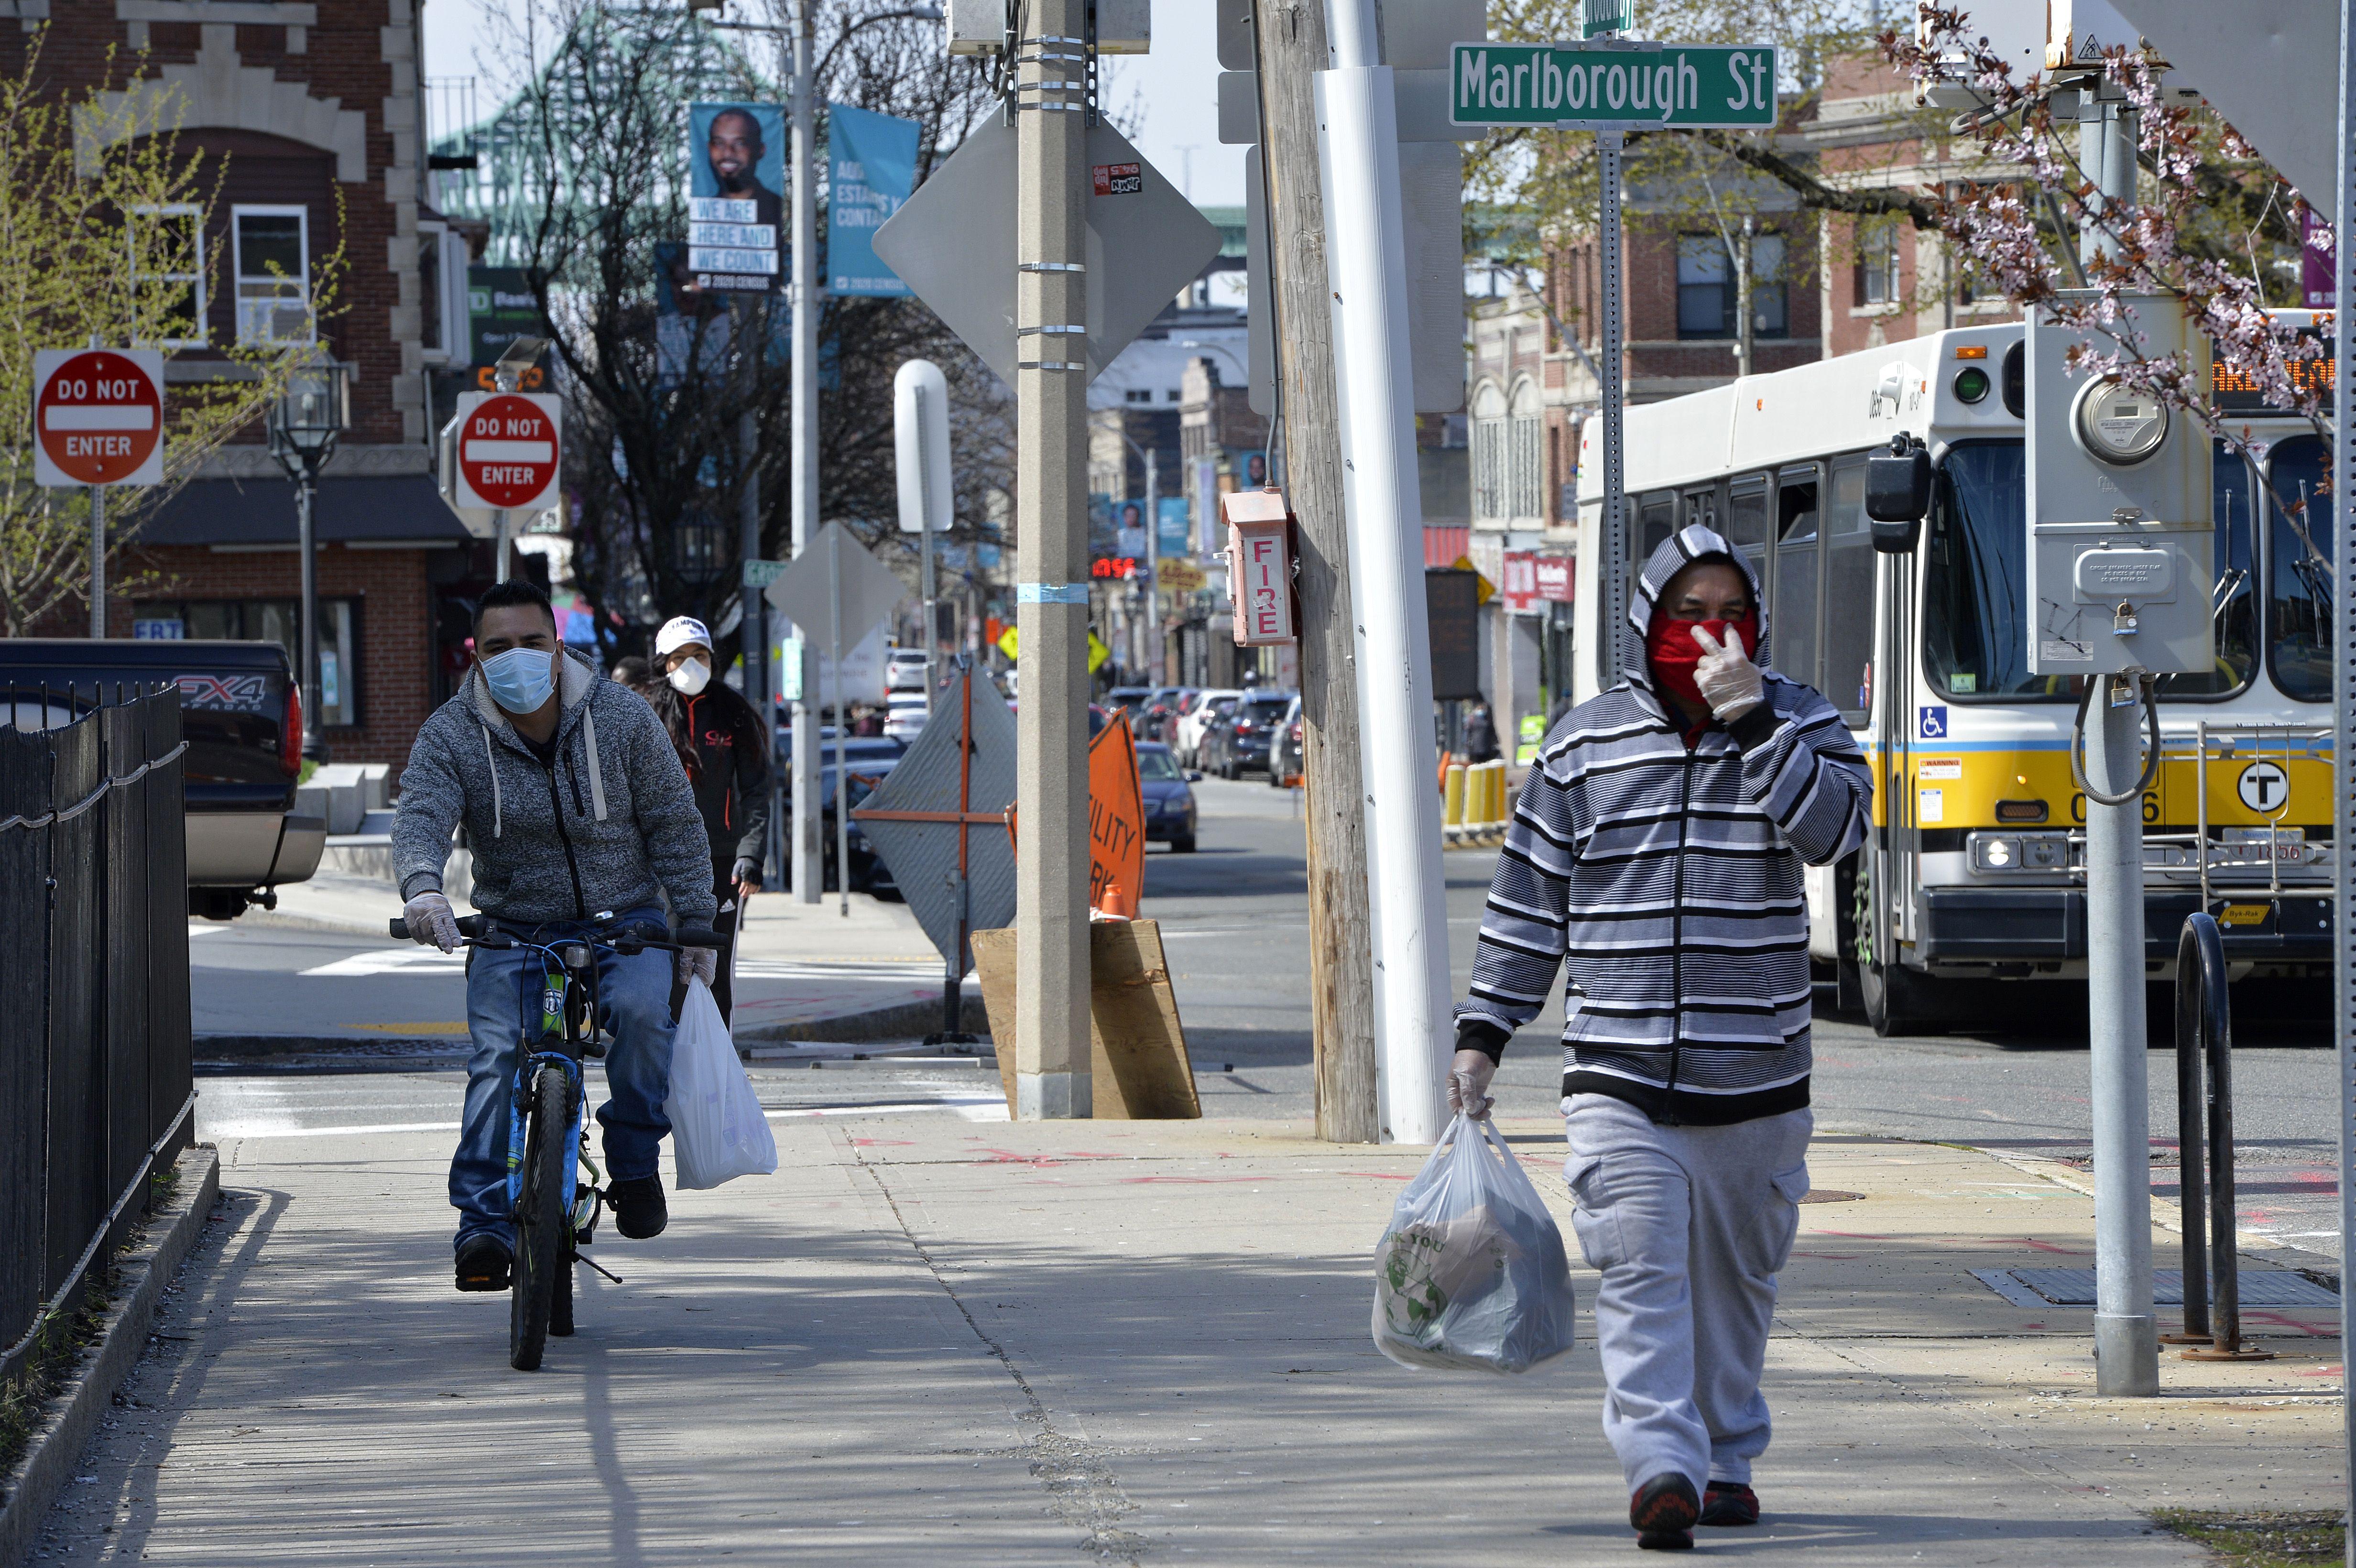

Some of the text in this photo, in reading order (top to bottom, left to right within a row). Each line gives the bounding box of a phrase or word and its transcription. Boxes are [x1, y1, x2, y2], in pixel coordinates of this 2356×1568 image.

[1461, 50, 1767, 122] Marlborough St
[697, 199, 752, 220] WE ARE
[698, 225, 771, 245] HERE AND
[697, 250, 771, 270] WE COUNT
[712, 274, 770, 290] 2020 CENSUS
[58, 379, 140, 400] DO NOT
[476, 417, 542, 437] DO NOT
[66, 436, 131, 457] ENTER
[482, 466, 534, 485] ENTER
[1254, 540, 1278, 634] FIRE
[171, 675, 265, 703] FX4
[214, 703, 262, 711] ROAD
[2247, 776, 2280, 804] T
[2071, 793, 2159, 823] 06
[1411, 1233, 1445, 1253] YOU
